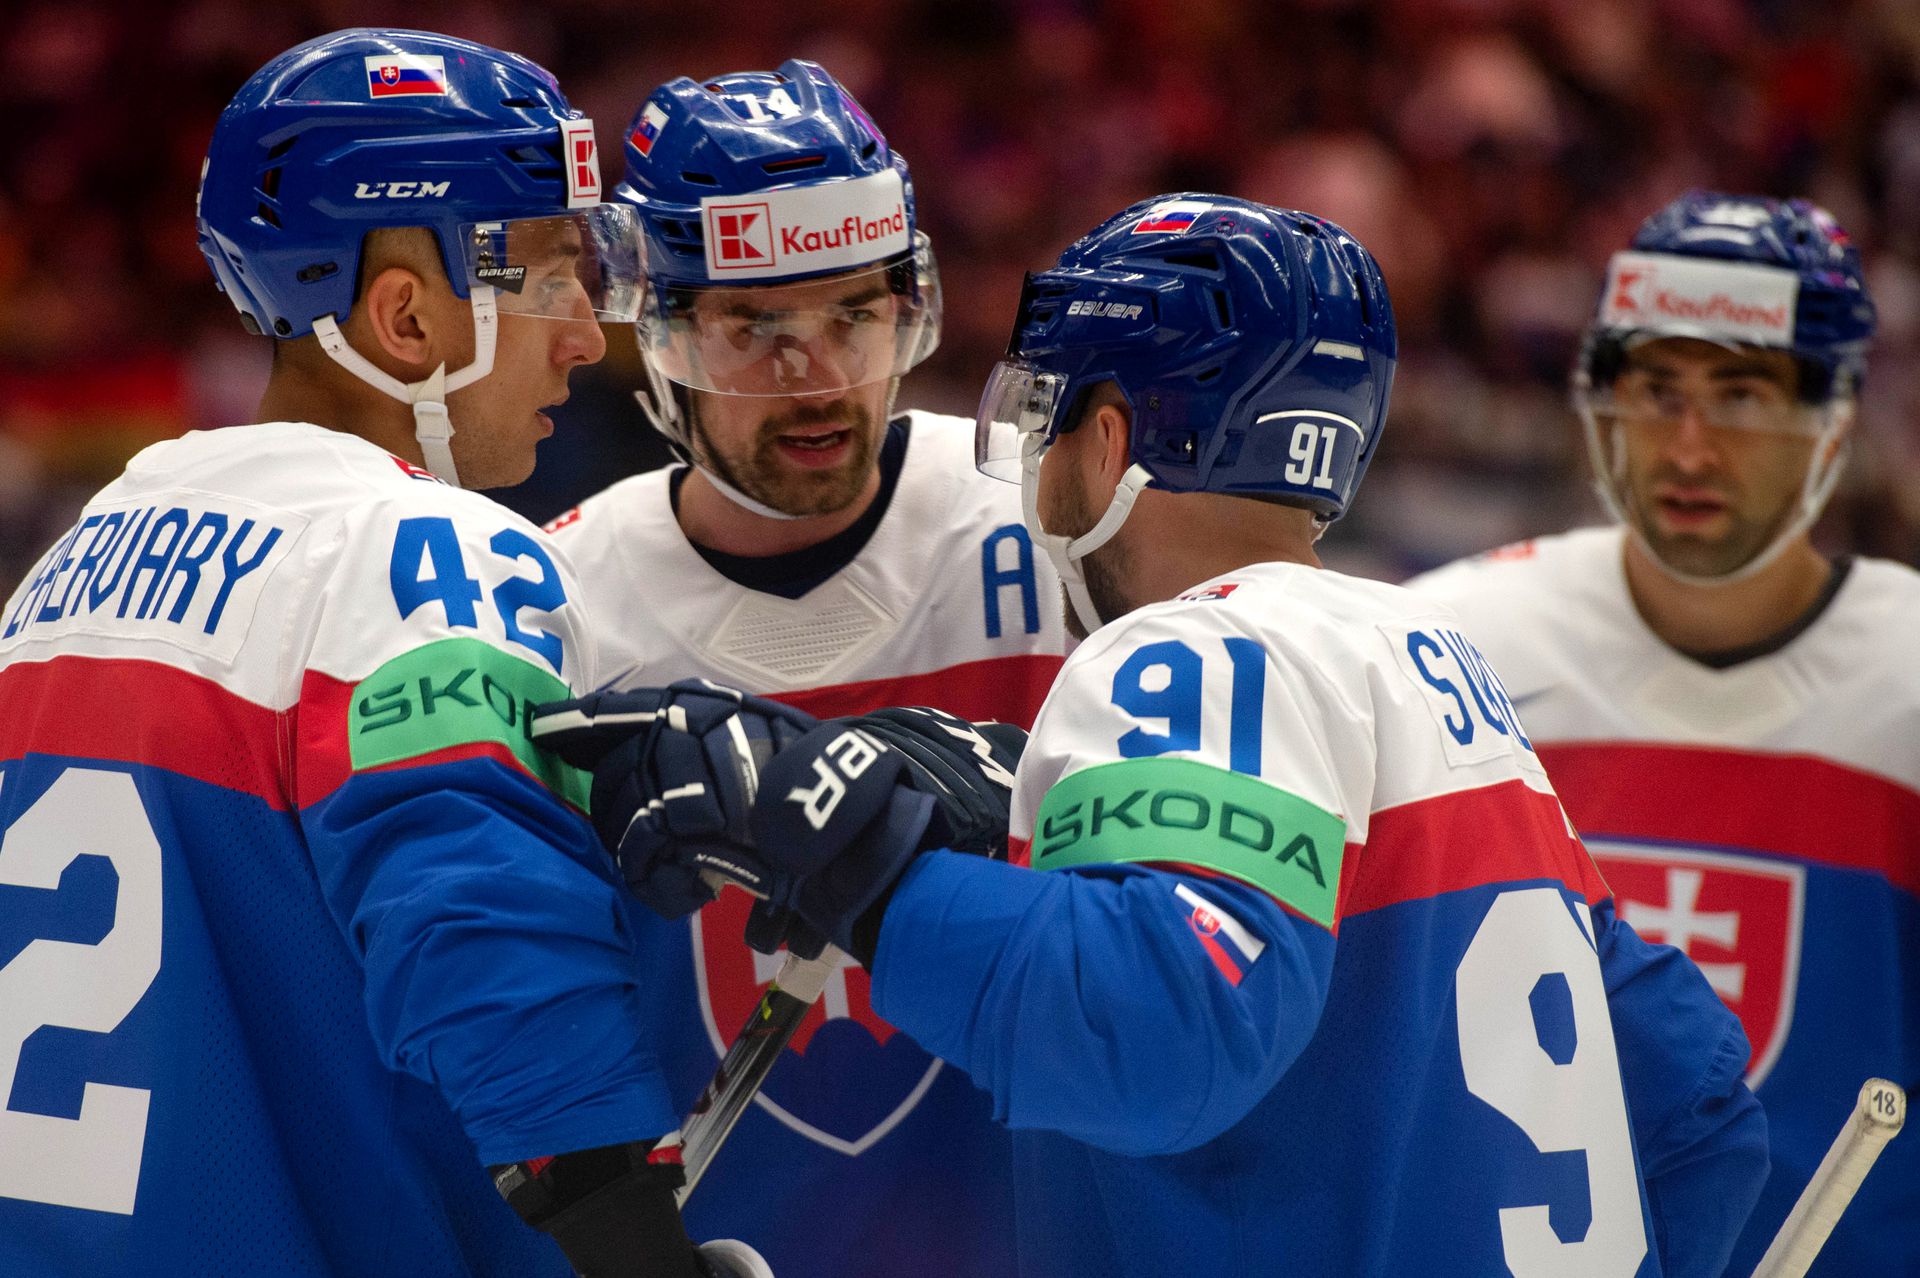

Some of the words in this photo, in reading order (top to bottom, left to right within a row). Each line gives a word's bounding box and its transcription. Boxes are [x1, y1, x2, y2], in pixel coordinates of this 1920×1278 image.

[354, 181, 451, 199] CCM
[718, 213, 765, 260] K
[781, 203, 904, 255] Kaufland
[1285, 423, 1338, 490] 91
[1, 506, 283, 640] EHERVARY
[390, 516, 568, 677] 42
[982, 523, 1040, 638] A
[359, 668, 538, 741] SKO
[1111, 637, 1266, 777] 91
[0, 767, 163, 1215] 2
[1456, 888, 1648, 1278] 9
[1873, 1089, 1896, 1116] 18
